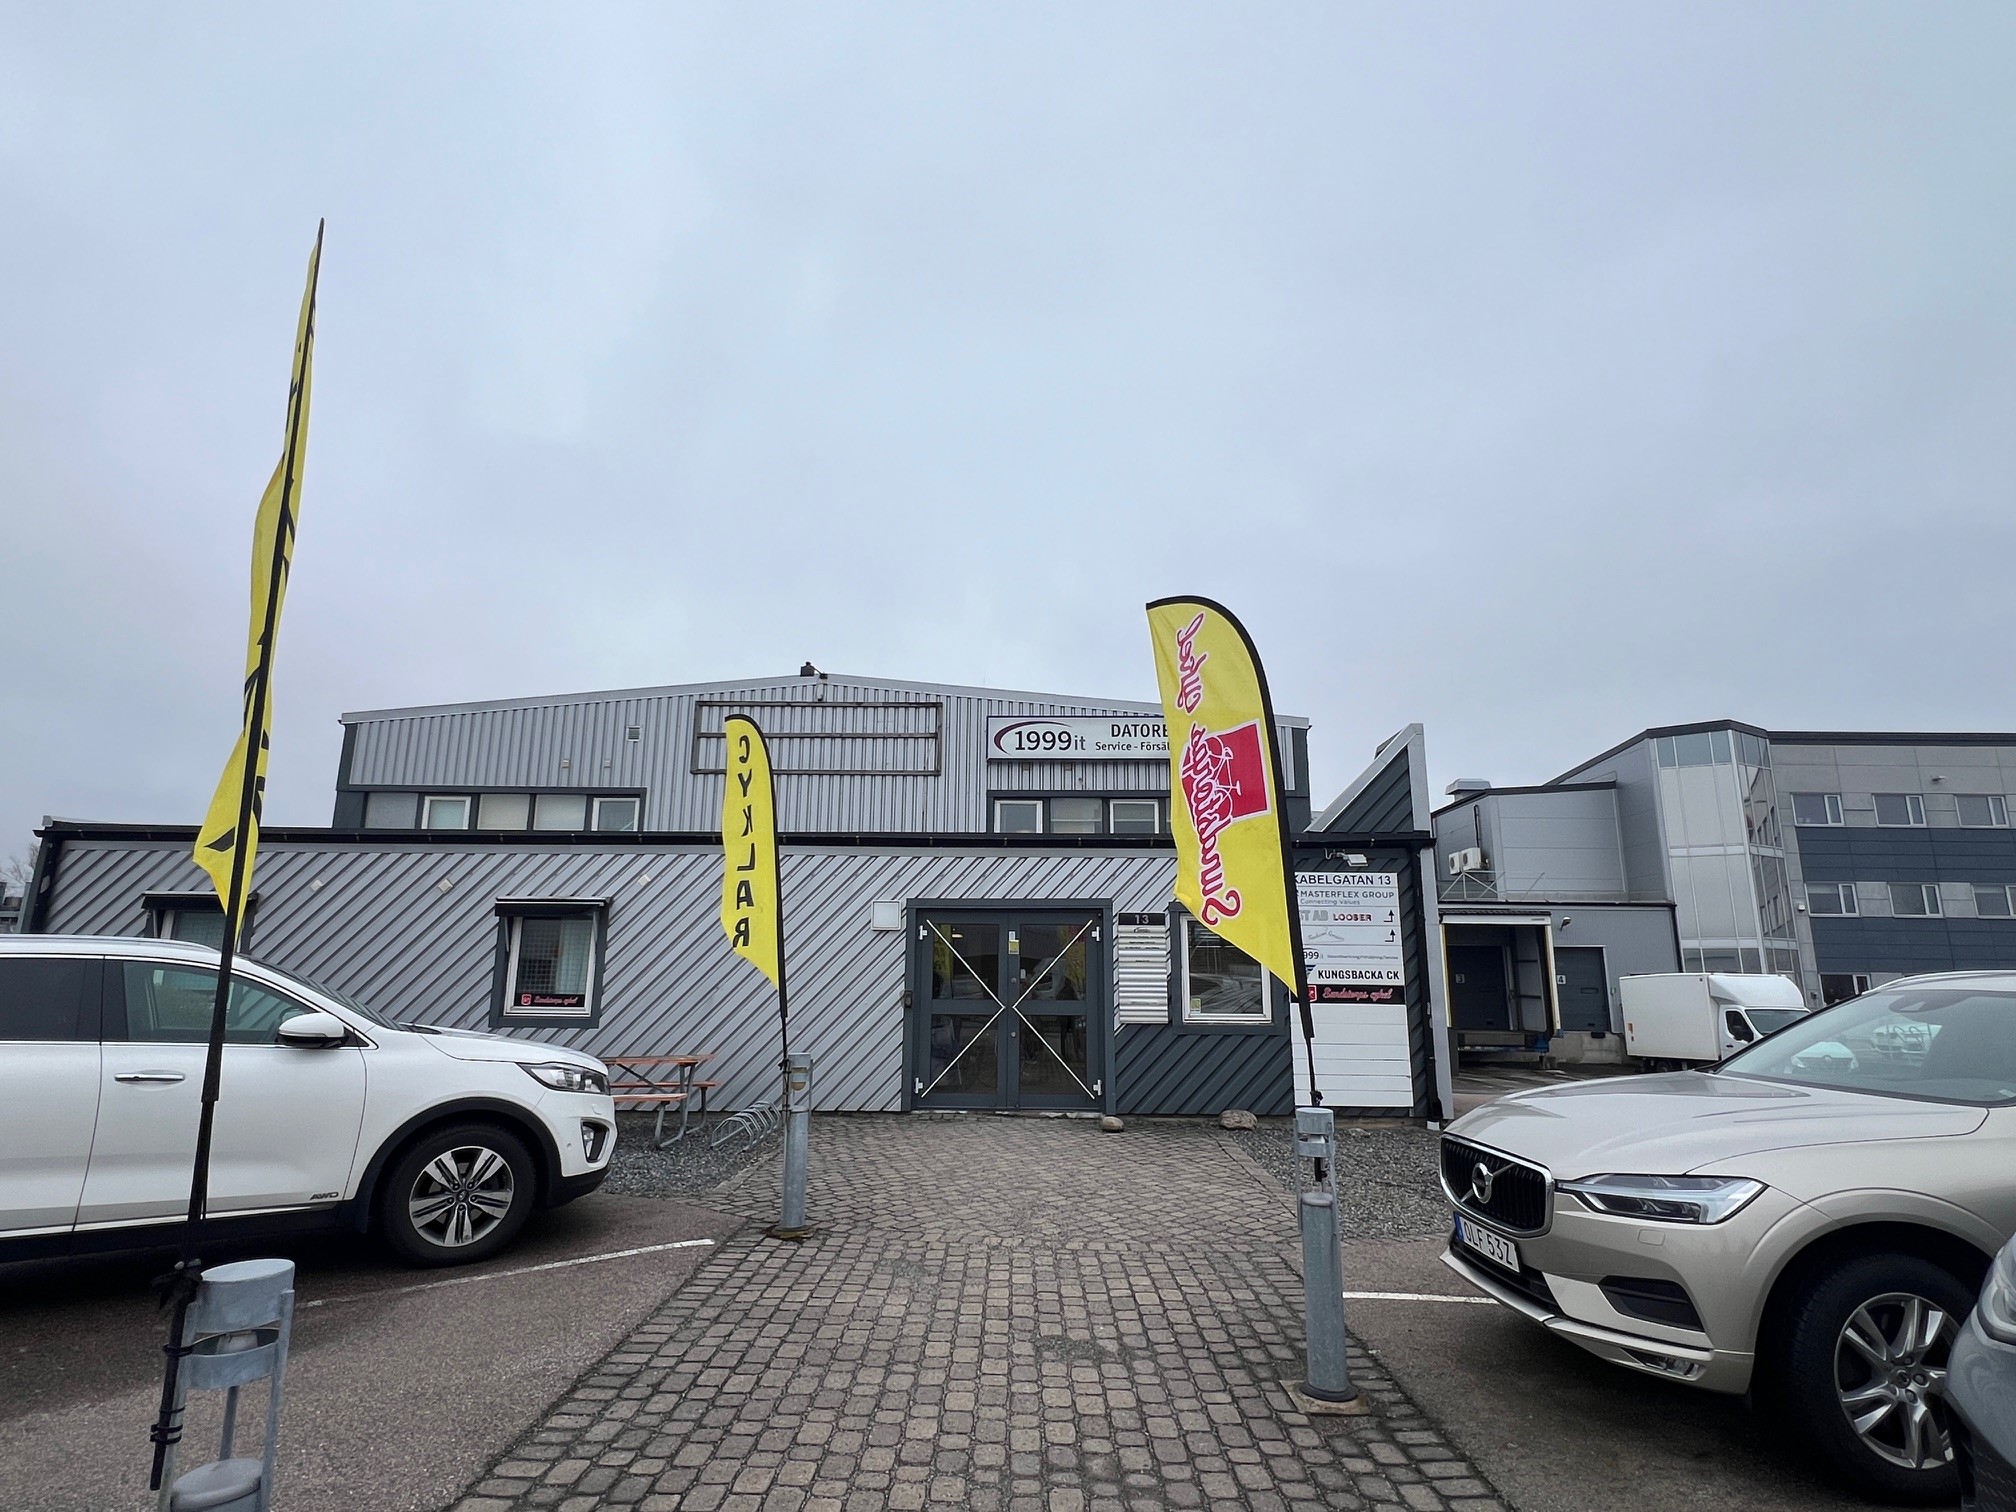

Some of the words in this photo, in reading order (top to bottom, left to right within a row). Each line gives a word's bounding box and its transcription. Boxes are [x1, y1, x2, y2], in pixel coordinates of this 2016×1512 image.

[1095, 741, 1132, 751] Service
[1140, 741, 1170, 751] Försäl
[1378, 875, 1391, 885] 13
[1300, 890, 1360, 899] MASTERFLEX
[1361, 891, 1394, 899] GROUP
[1300, 898, 1337, 906] Connecting
[1134, 914, 1150, 924] 13
[1312, 909, 1329, 921] AB
[1318, 969, 1384, 980] KUNGSBACKA
[1387, 970, 1400, 980] CK
[309, 1191, 339, 1201] AWD
